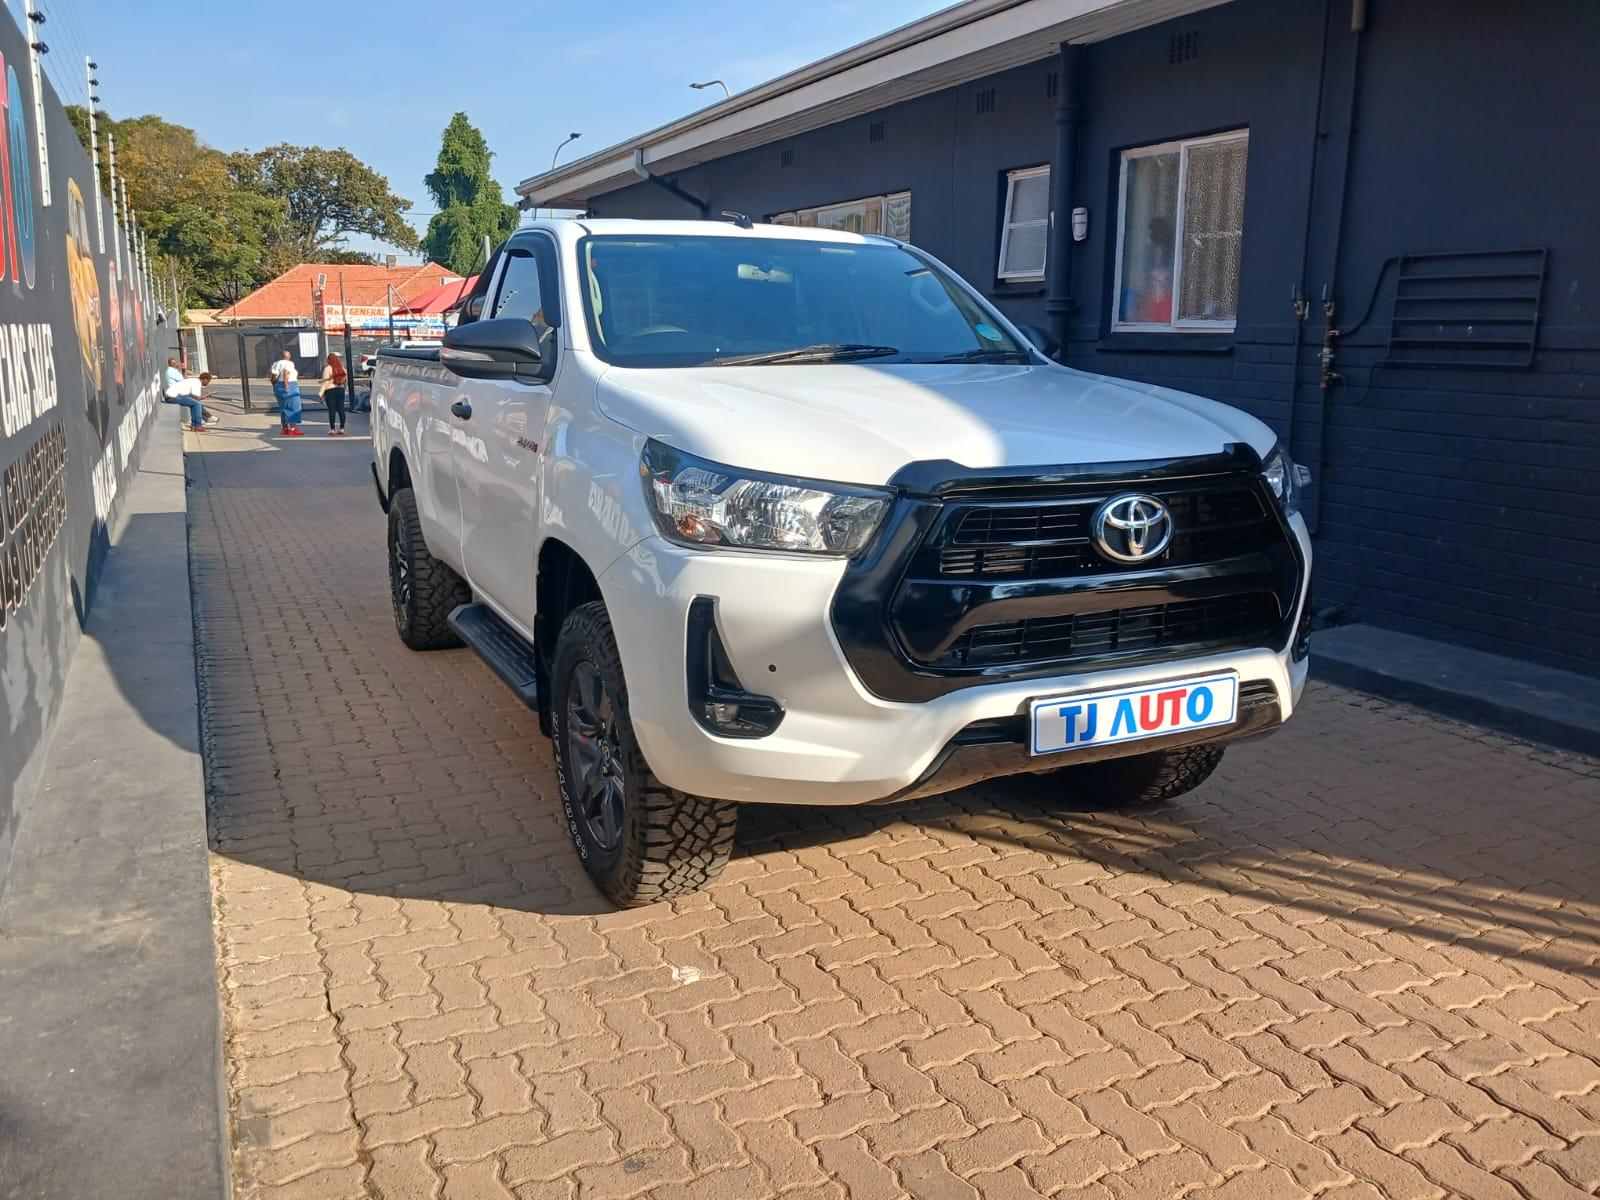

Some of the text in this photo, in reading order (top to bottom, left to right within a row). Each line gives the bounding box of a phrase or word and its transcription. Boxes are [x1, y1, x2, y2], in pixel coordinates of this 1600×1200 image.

[28, 323, 57, 418] SALES
[1059, 686, 1213, 743] TJ AUTO
